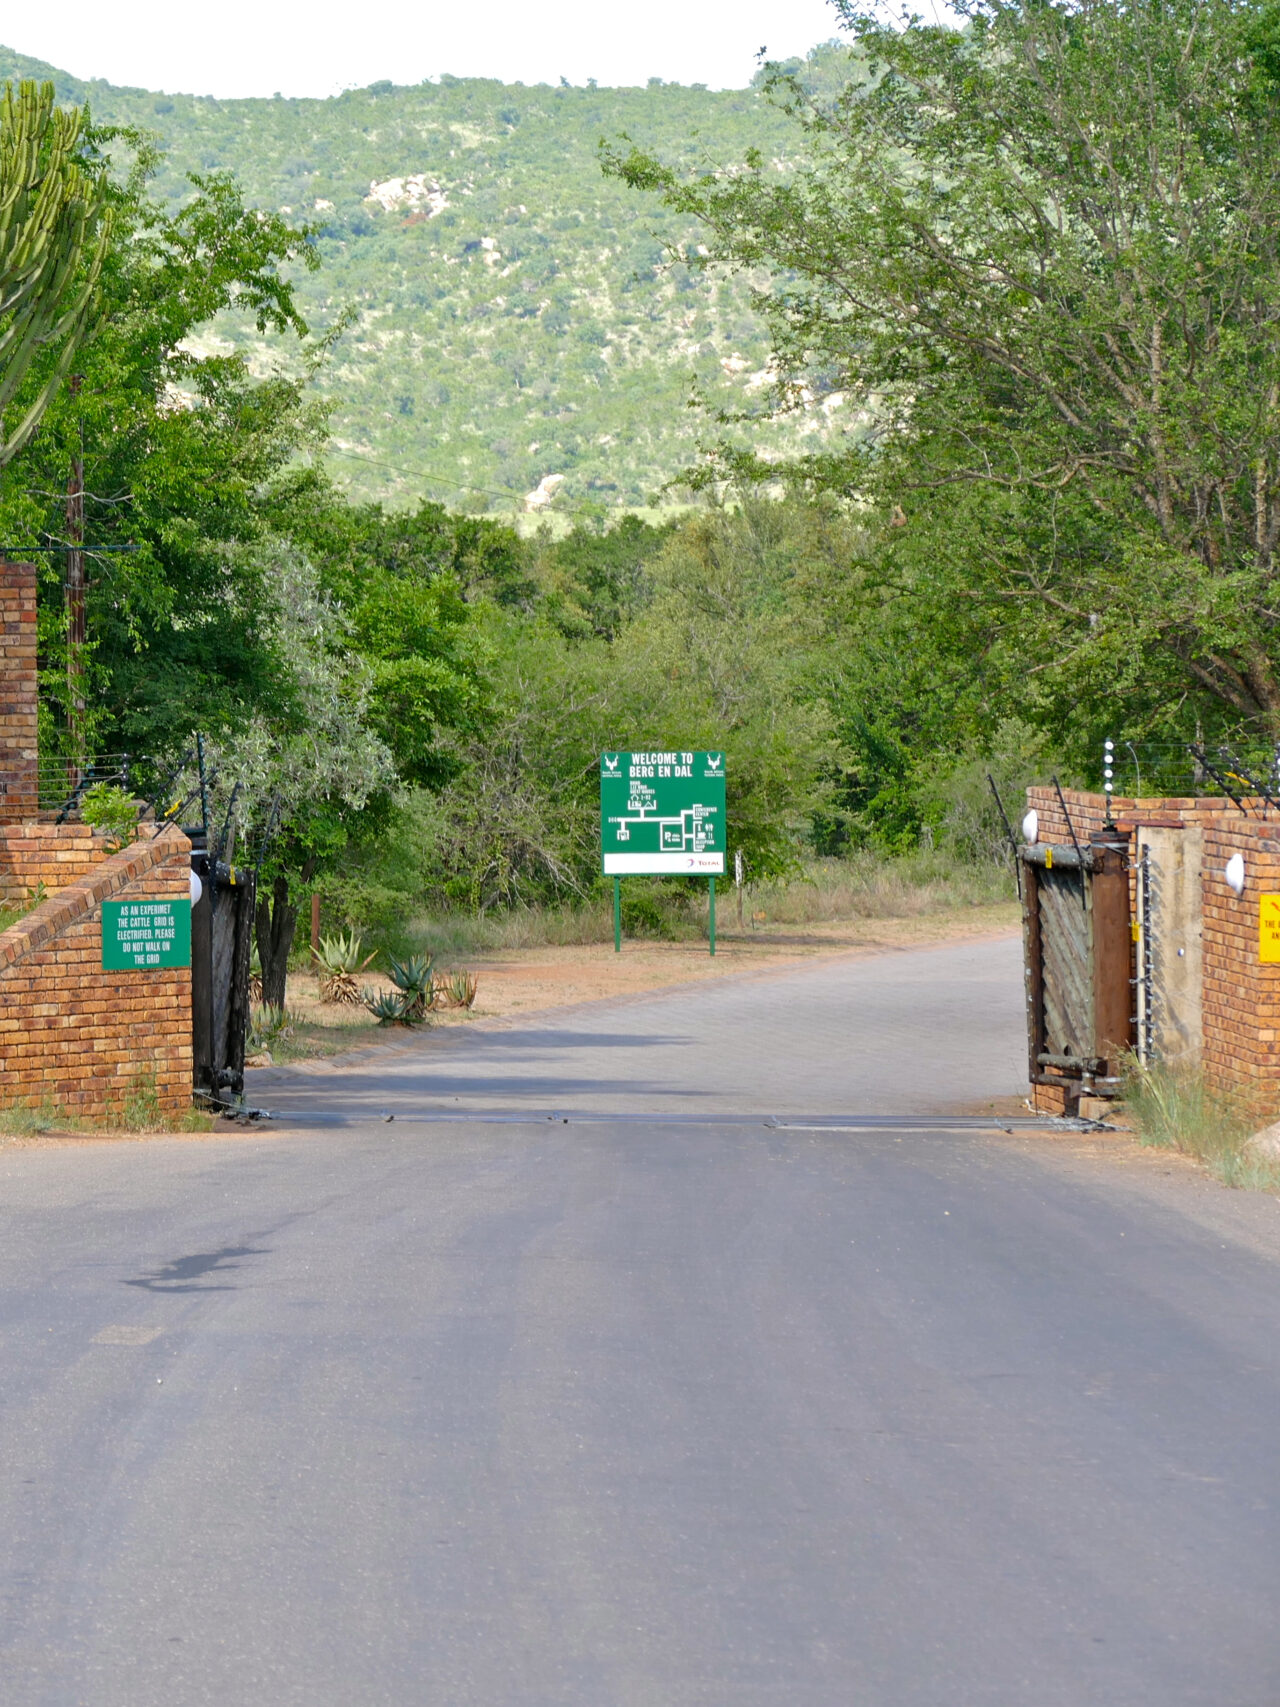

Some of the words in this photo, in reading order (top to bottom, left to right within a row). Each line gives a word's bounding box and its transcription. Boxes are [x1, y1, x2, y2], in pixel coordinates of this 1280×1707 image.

[631, 752, 677, 765] WELCOME
[681, 752, 693, 765] TO
[629, 765, 655, 778] BERG
[658, 765, 671, 778] EN
[675, 765, 693, 778] DAL
[120, 906, 129, 916] AS
[130, 905, 139, 915] AN
[140, 904, 171, 915] EXPERIMET
[117, 918, 128, 928] THE
[130, 917, 150, 927] CATTLE
[153, 916, 167, 927] GRID
[168, 916, 175, 927] IS
[117, 929, 153, 940] ELECTRIFIED.
[154, 928, 176, 939] PLEASE
[122, 942, 131, 952] DO
[132, 942, 144, 952] NOT
[145, 941, 160, 952] WALK
[162, 941, 170, 951] ON
[134, 954, 145, 965] THE
[146, 954, 160, 964] GRID
